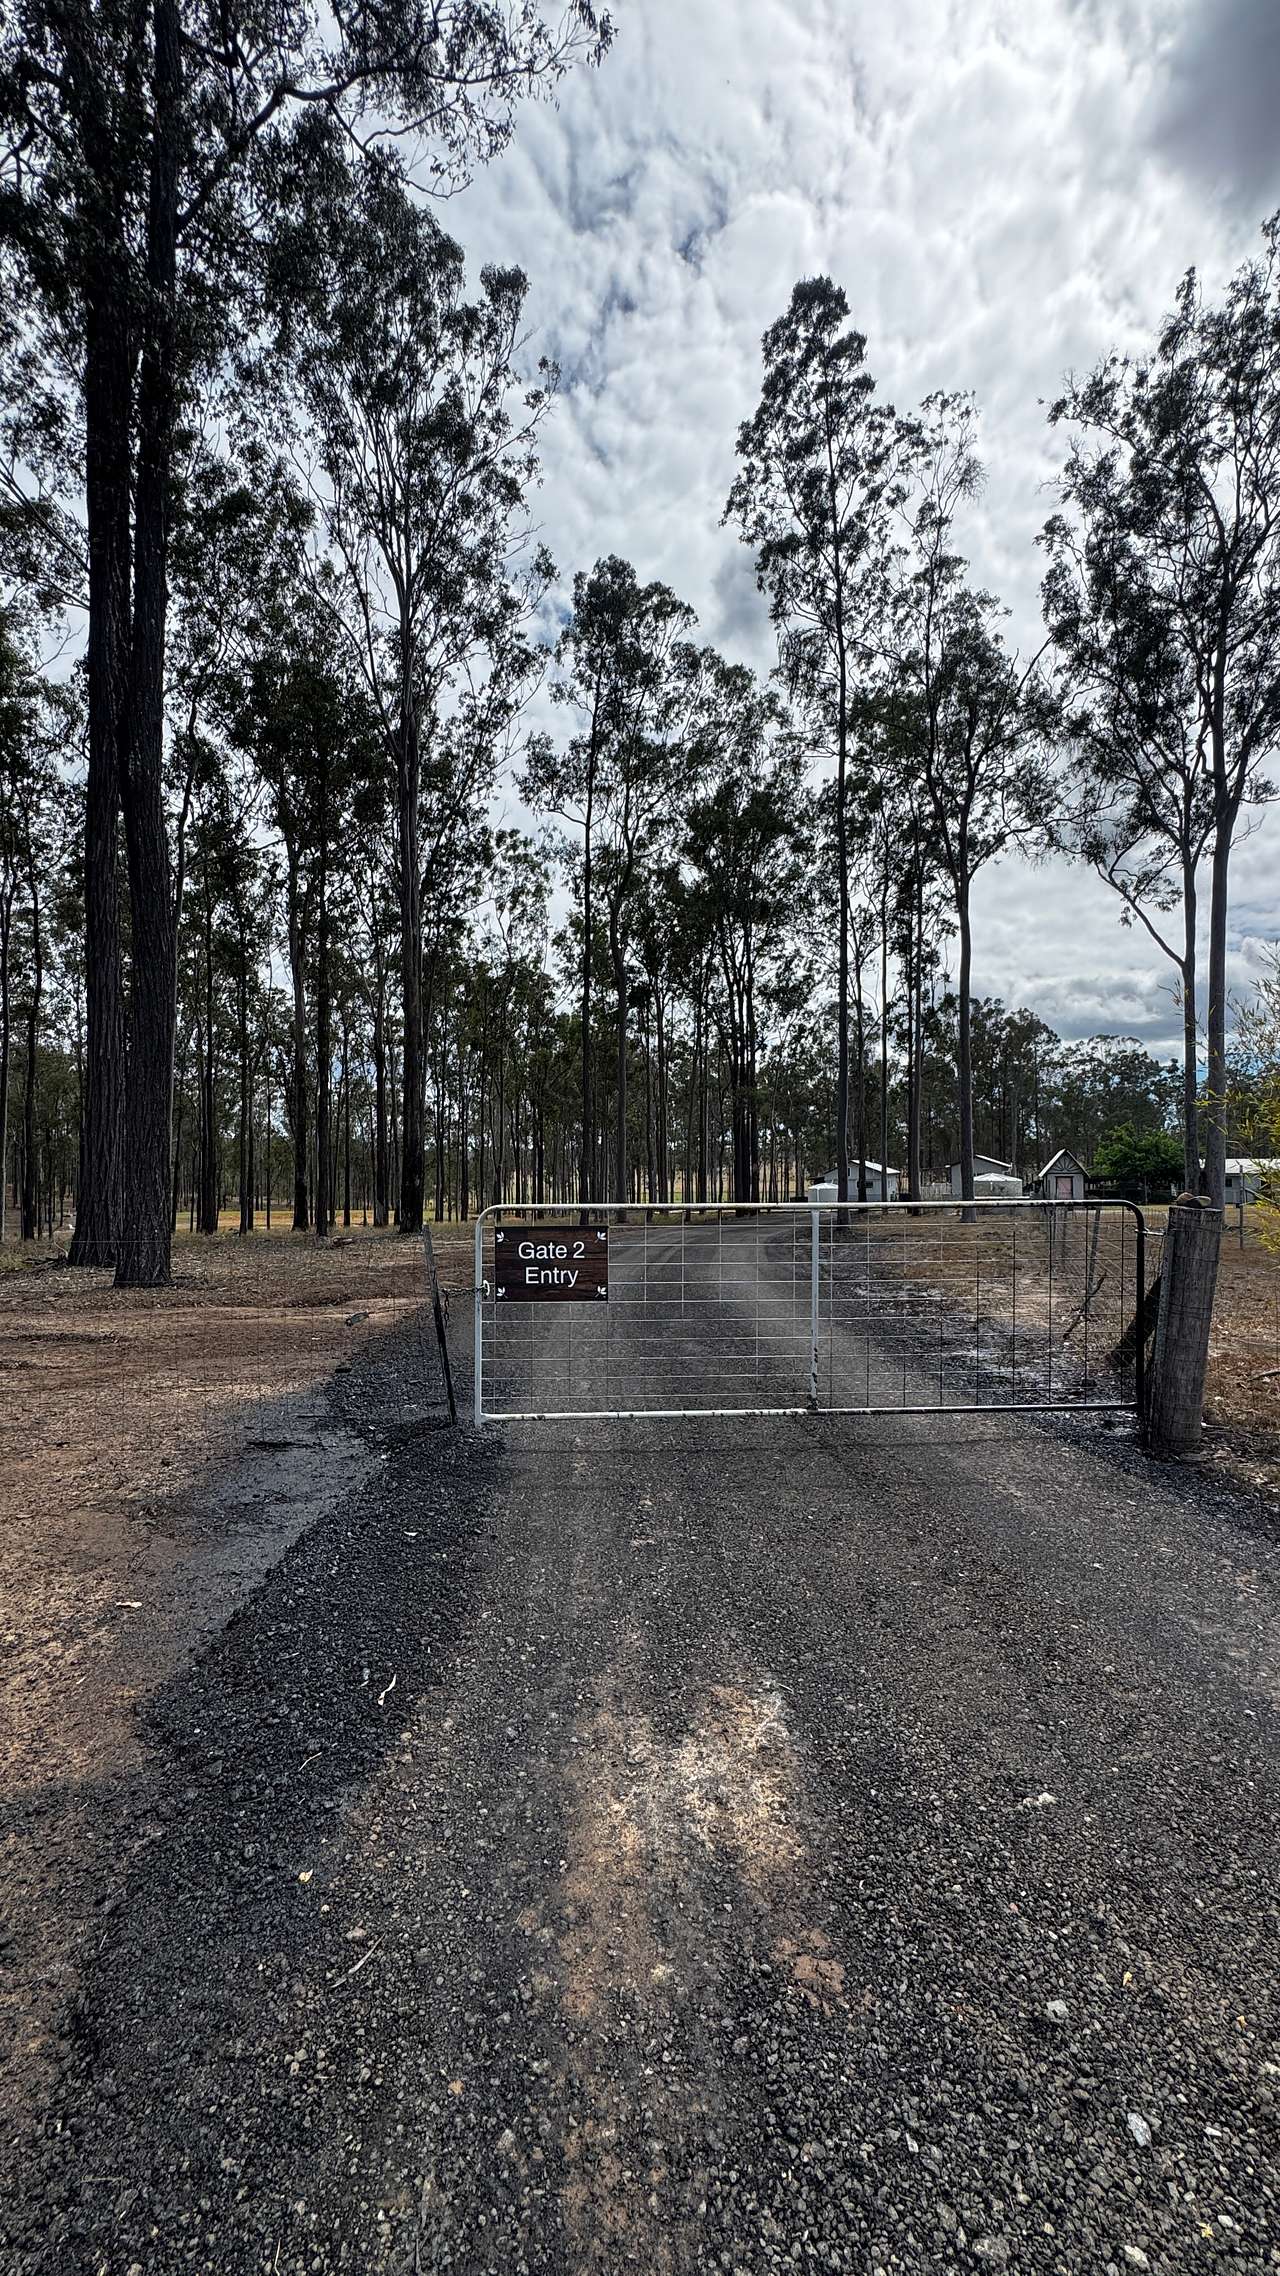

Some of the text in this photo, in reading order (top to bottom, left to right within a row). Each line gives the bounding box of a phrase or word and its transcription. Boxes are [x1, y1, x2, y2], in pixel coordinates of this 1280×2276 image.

[518, 1241, 586, 1259] Gate 2
[525, 1266, 579, 1288] Entry
